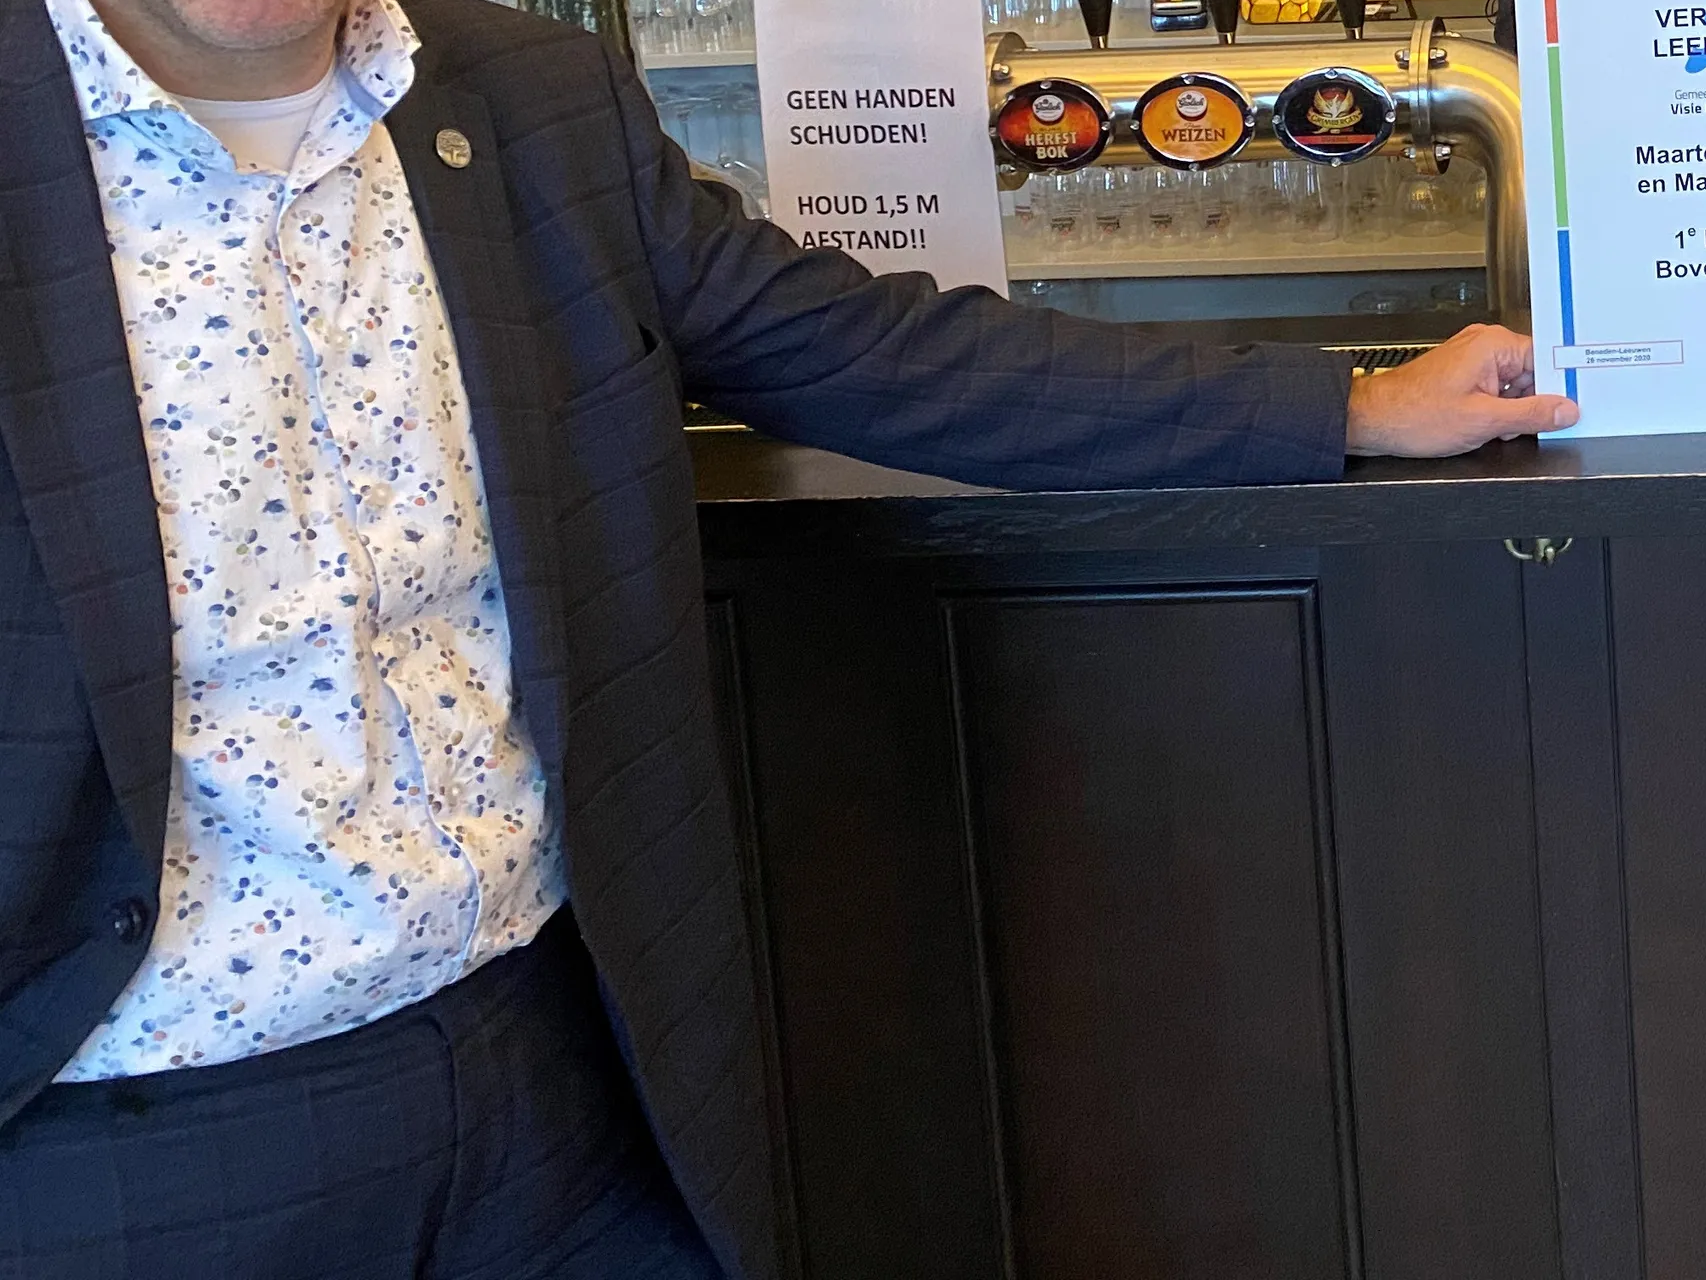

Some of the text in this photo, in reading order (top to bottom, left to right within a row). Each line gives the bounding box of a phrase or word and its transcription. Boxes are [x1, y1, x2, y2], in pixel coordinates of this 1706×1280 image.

[787, 88, 956, 110] GEEN HANDEN
[1671, 102, 1702, 115] Visie
[790, 122, 928, 146] SCHUDDEN!
[1024, 131, 1077, 147] HERFST
[1161, 128, 1226, 142] WEIZEN
[1035, 144, 1069, 160] BOK
[1637, 178, 1666, 193] en
[797, 194, 940, 219] HOUD 1,5 M
